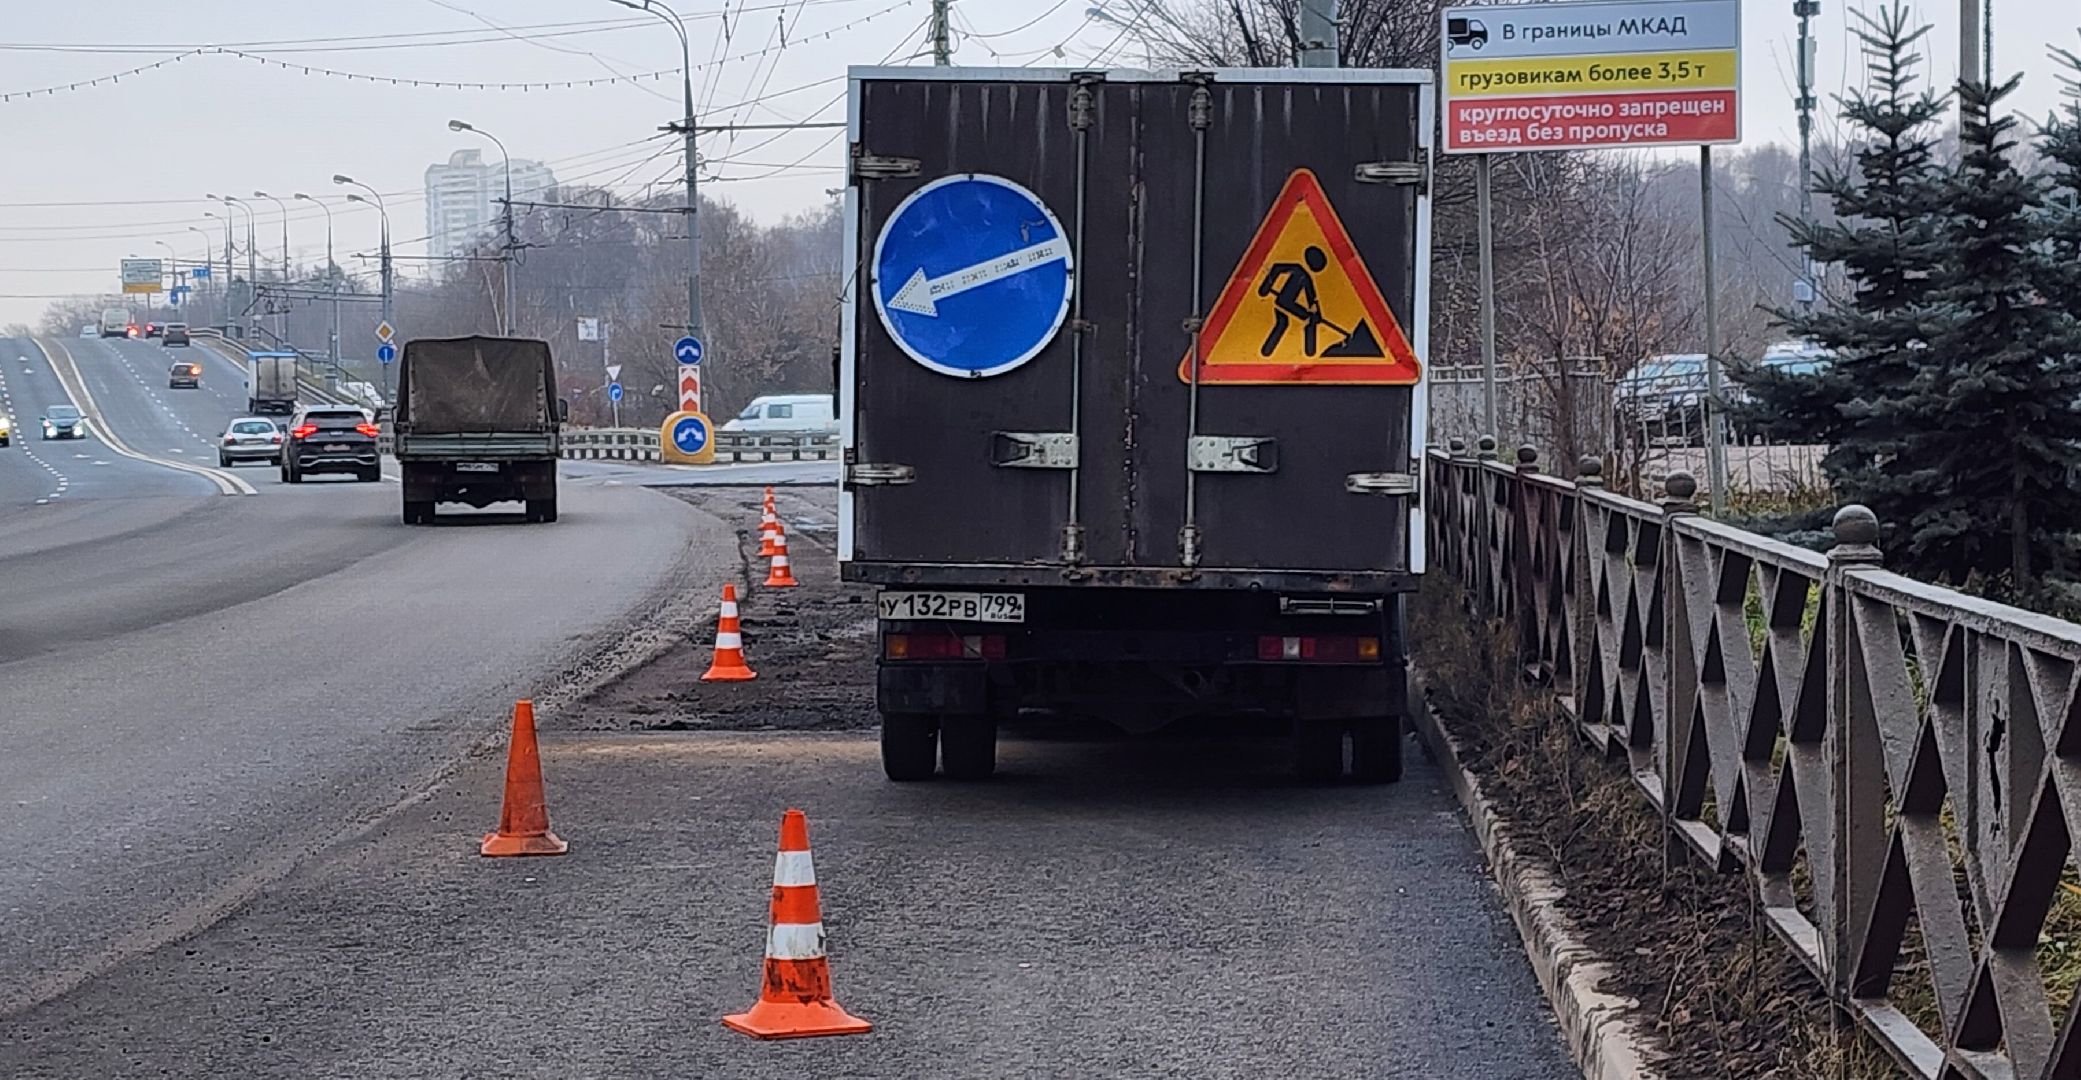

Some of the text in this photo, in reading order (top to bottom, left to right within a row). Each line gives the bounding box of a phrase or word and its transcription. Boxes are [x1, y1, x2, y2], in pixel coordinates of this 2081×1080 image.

[1502, 16, 1687, 43] В границы МКАД
[1460, 61, 1706, 89] грузовикам более 3,5 т
[1459, 99, 1725, 125] круглосуточно запрещен
[1460, 122, 1668, 144] въезд без пропуска
